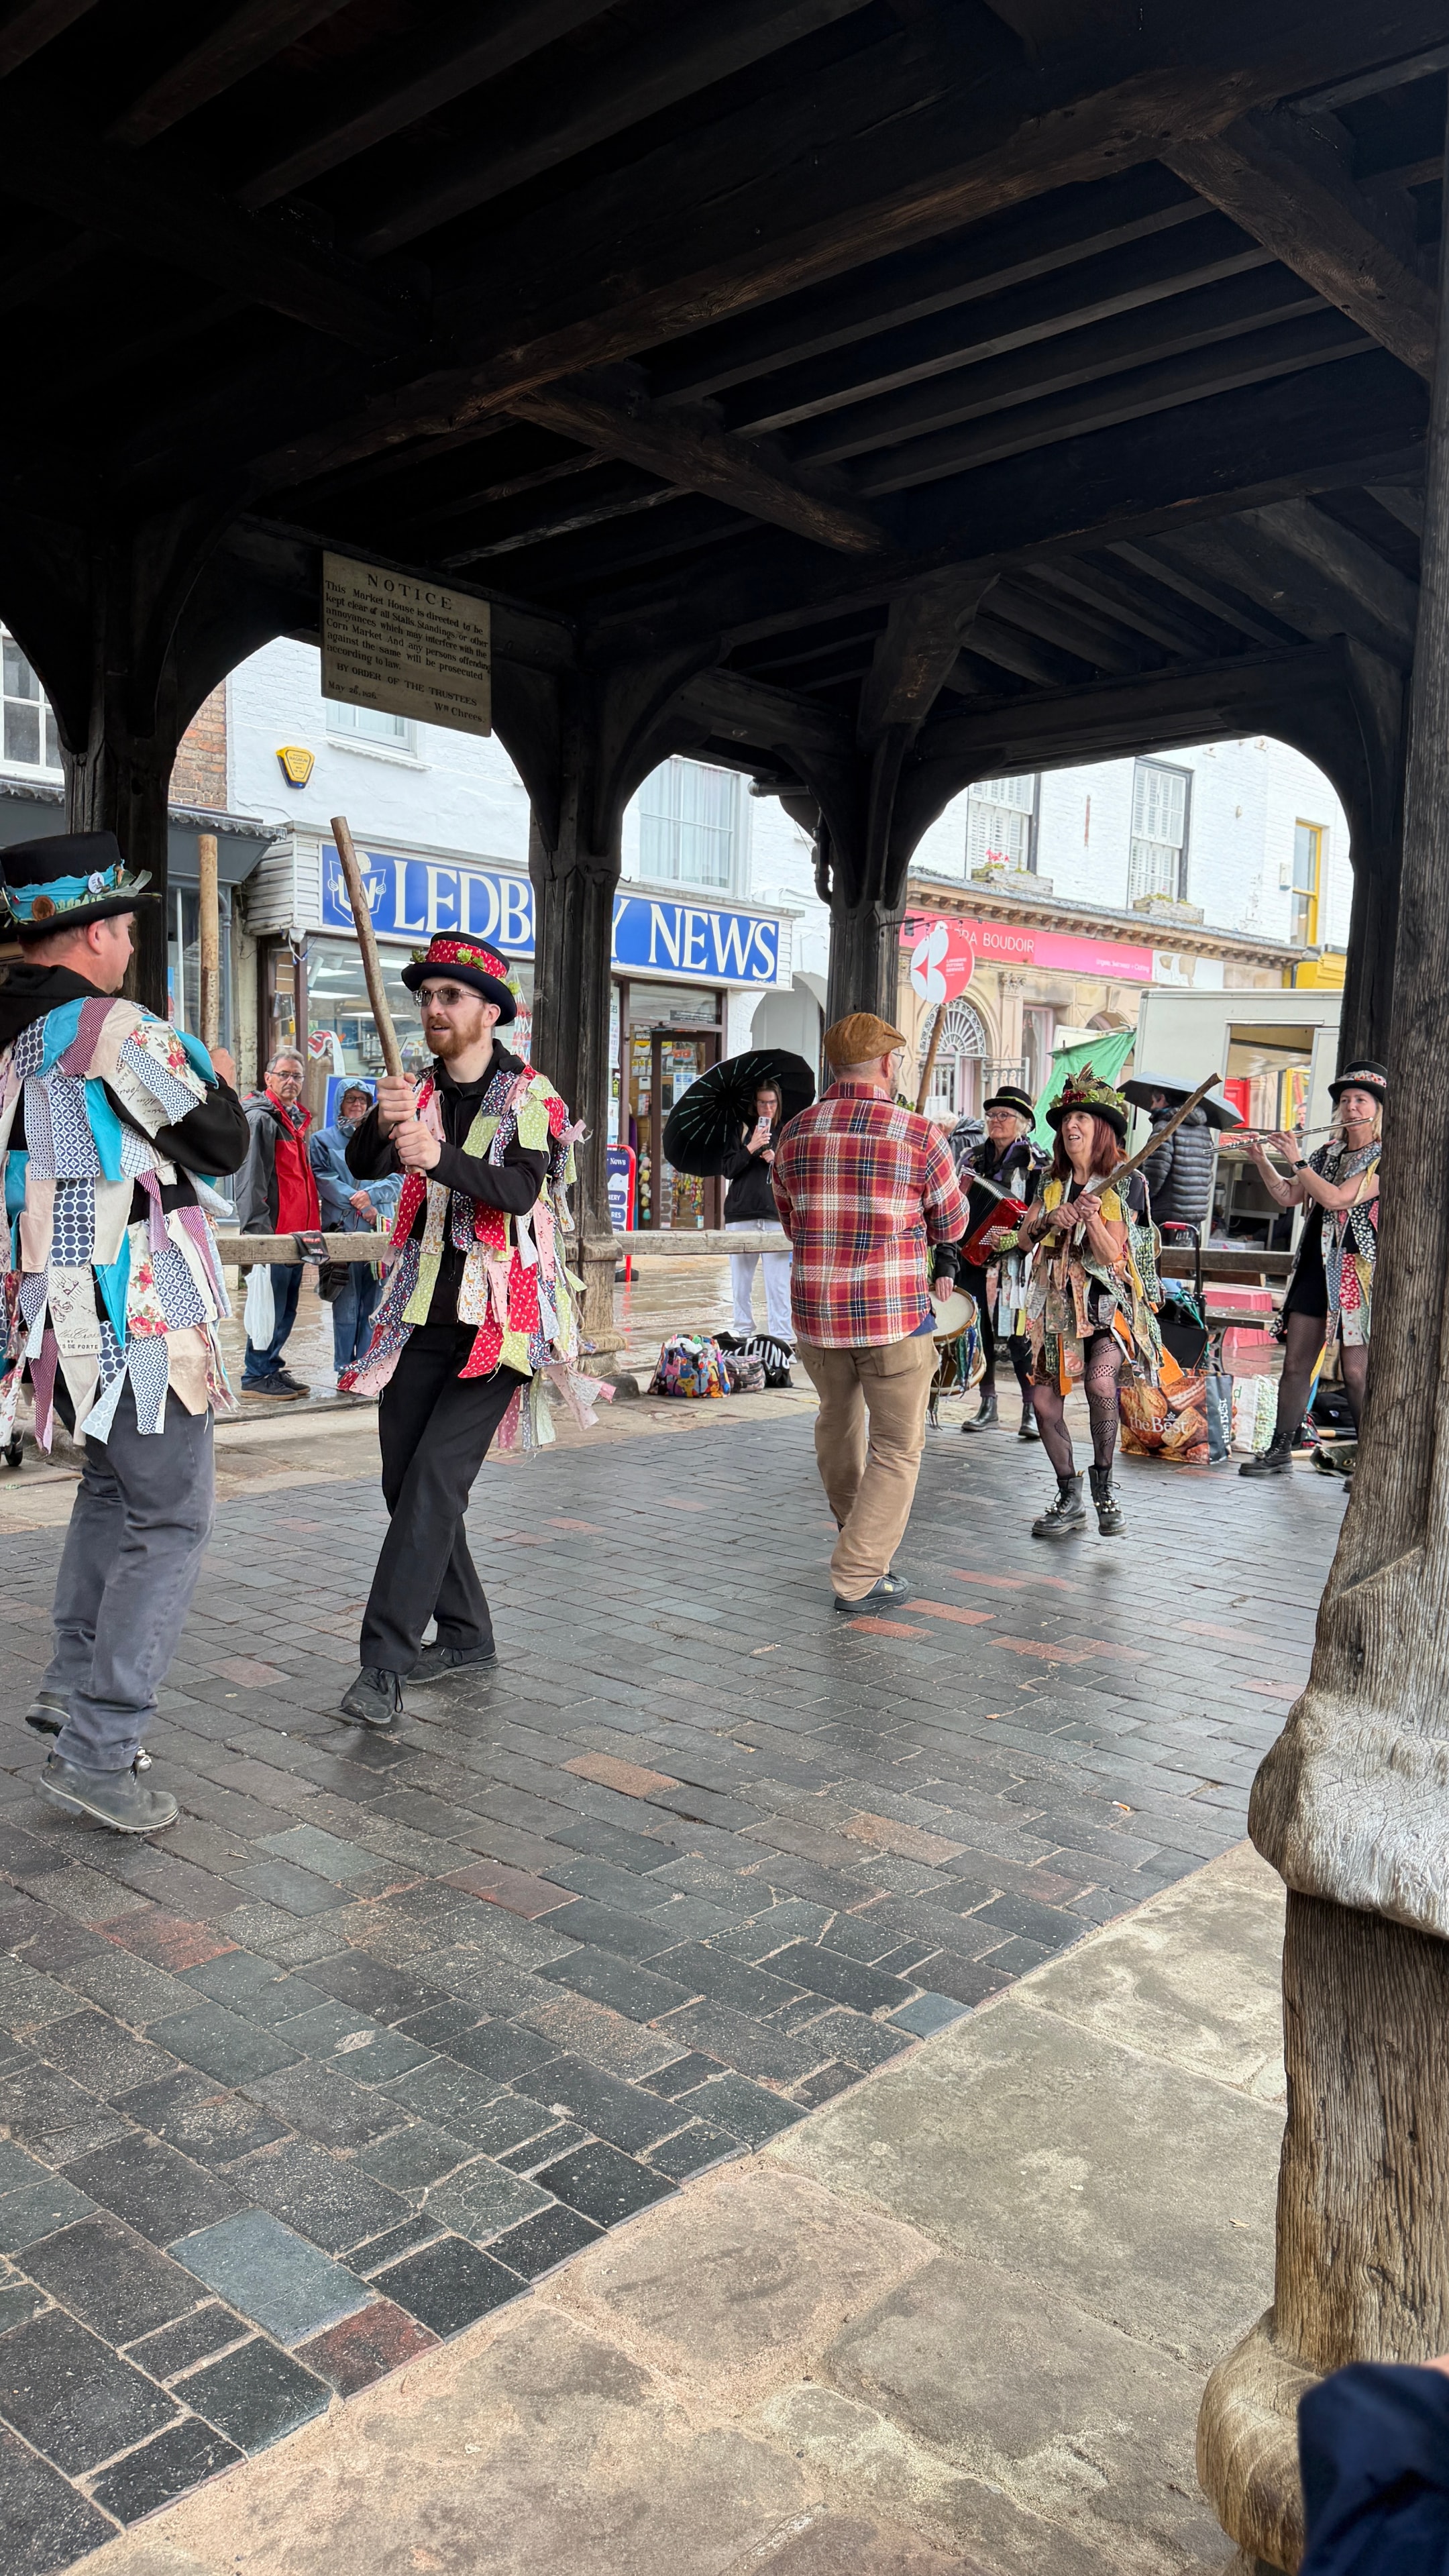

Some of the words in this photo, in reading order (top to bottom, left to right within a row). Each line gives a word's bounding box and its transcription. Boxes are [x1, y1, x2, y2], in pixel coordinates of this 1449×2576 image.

[325, 580, 345, 594] This
[353, 588, 383, 604] Market
[388, 599, 414, 614] House
[417, 608, 424, 617] is
[427, 612, 459, 628] directed
[464, 621, 470, 631] to
[474, 625, 483, 635] be
[368, 574, 451, 610] NOTICE
[326, 592, 344, 607] kept
[347, 600, 368, 612] clear
[370, 607, 378, 615] of
[380, 610, 389, 619] all
[470, 638, 488, 648] other
[326, 606, 376, 627] annoyances
[380, 621, 402, 635] which
[407, 630, 422, 642] may
[426, 635, 457, 651] interfere
[459, 645, 474, 655] with
[476, 647, 487, 659] the
[326, 618, 347, 631] Corn
[352, 626, 382, 641] Market
[387, 636, 404, 647] And
[409, 642, 423, 653] any
[426, 648, 456, 661] persons
[460, 656, 492, 674] offending
[327, 632, 359, 647] against
[362, 639, 375, 651] the
[379, 647, 401, 657] same
[407, 653, 421, 663] will
[426, 658, 435, 667] be
[439, 662, 483, 680] prosecuted
[327, 644, 372, 664] according
[376, 655, 383, 665] to
[385, 657, 401, 669] law.
[328, 680, 345, 693] May
[337, 663, 349, 672] BY
[352, 667, 381, 680] ORDER
[388, 676, 400, 684] OF
[404, 680, 424, 692] THE
[429, 686, 477, 706] TRUSTEES
[393, 859, 631, 958] LEDBY
[648, 903, 775, 979] NEWS
[983, 933, 1034, 953] BOUDOIR
